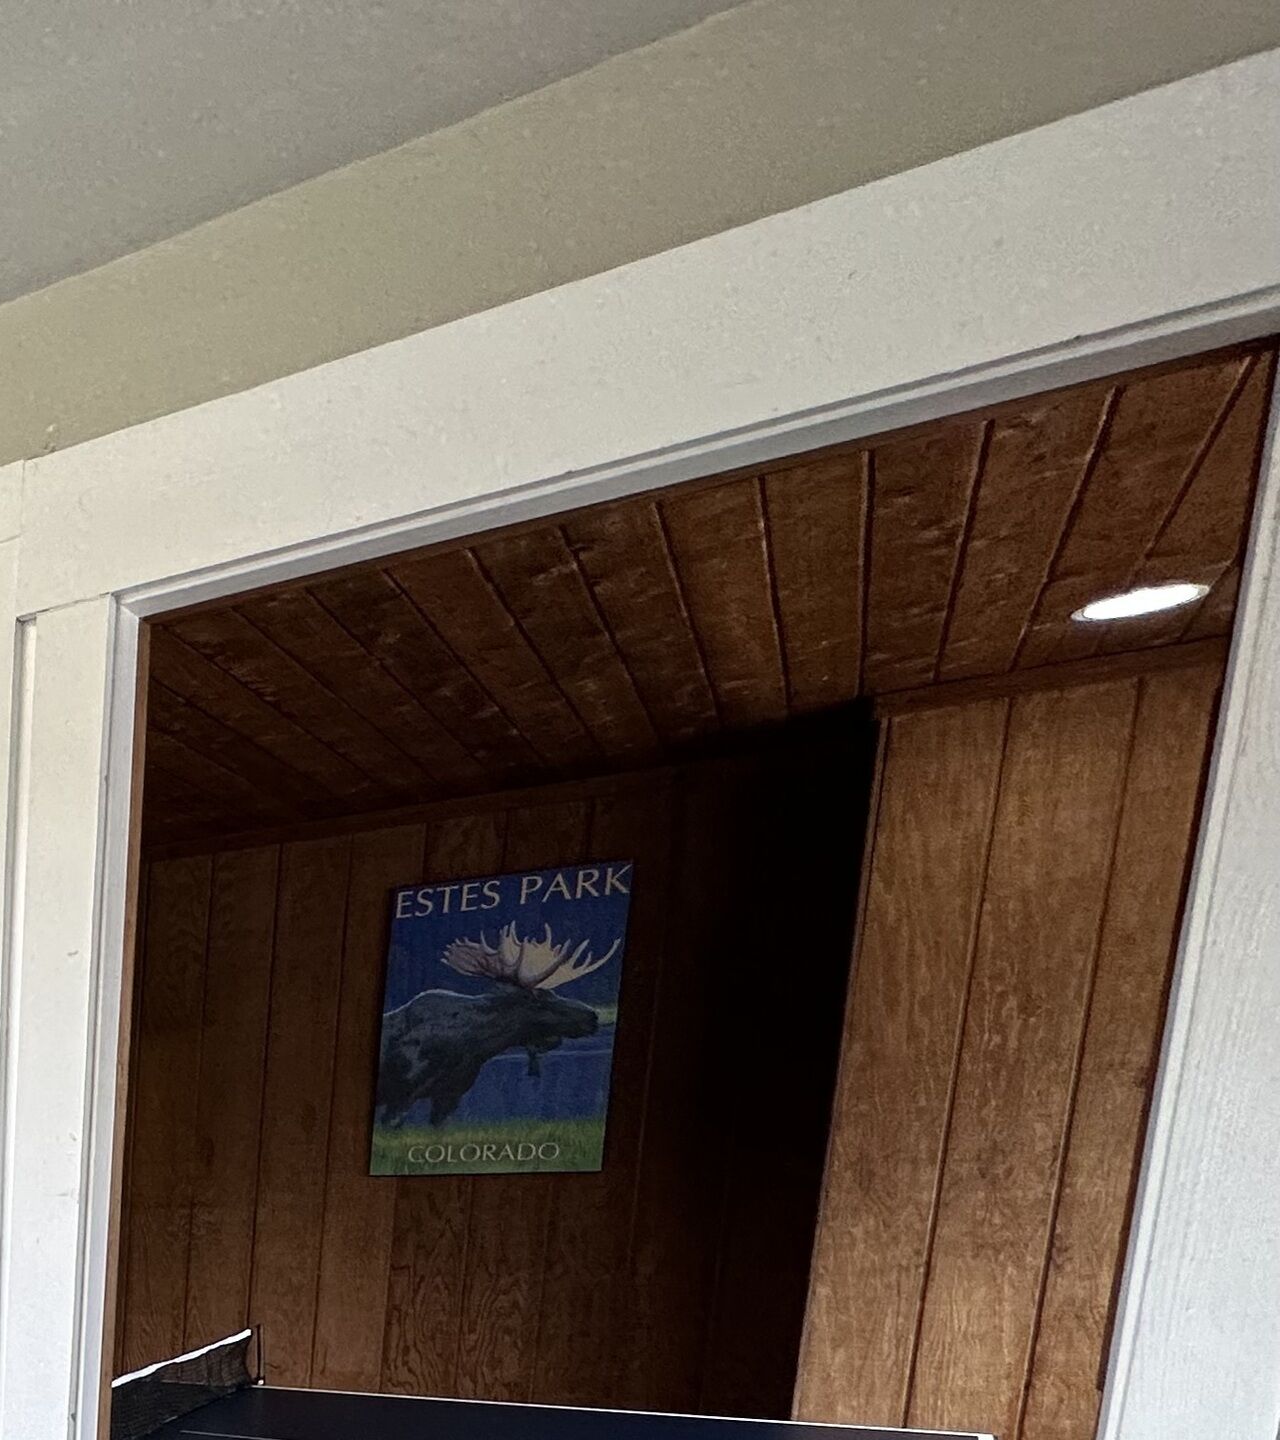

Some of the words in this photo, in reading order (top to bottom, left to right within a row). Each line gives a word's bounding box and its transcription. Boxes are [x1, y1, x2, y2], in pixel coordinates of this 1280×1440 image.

[395, 880, 501, 919] ESTES
[520, 863, 633, 905] PARK
[407, 1141, 561, 1164] COLORADO
